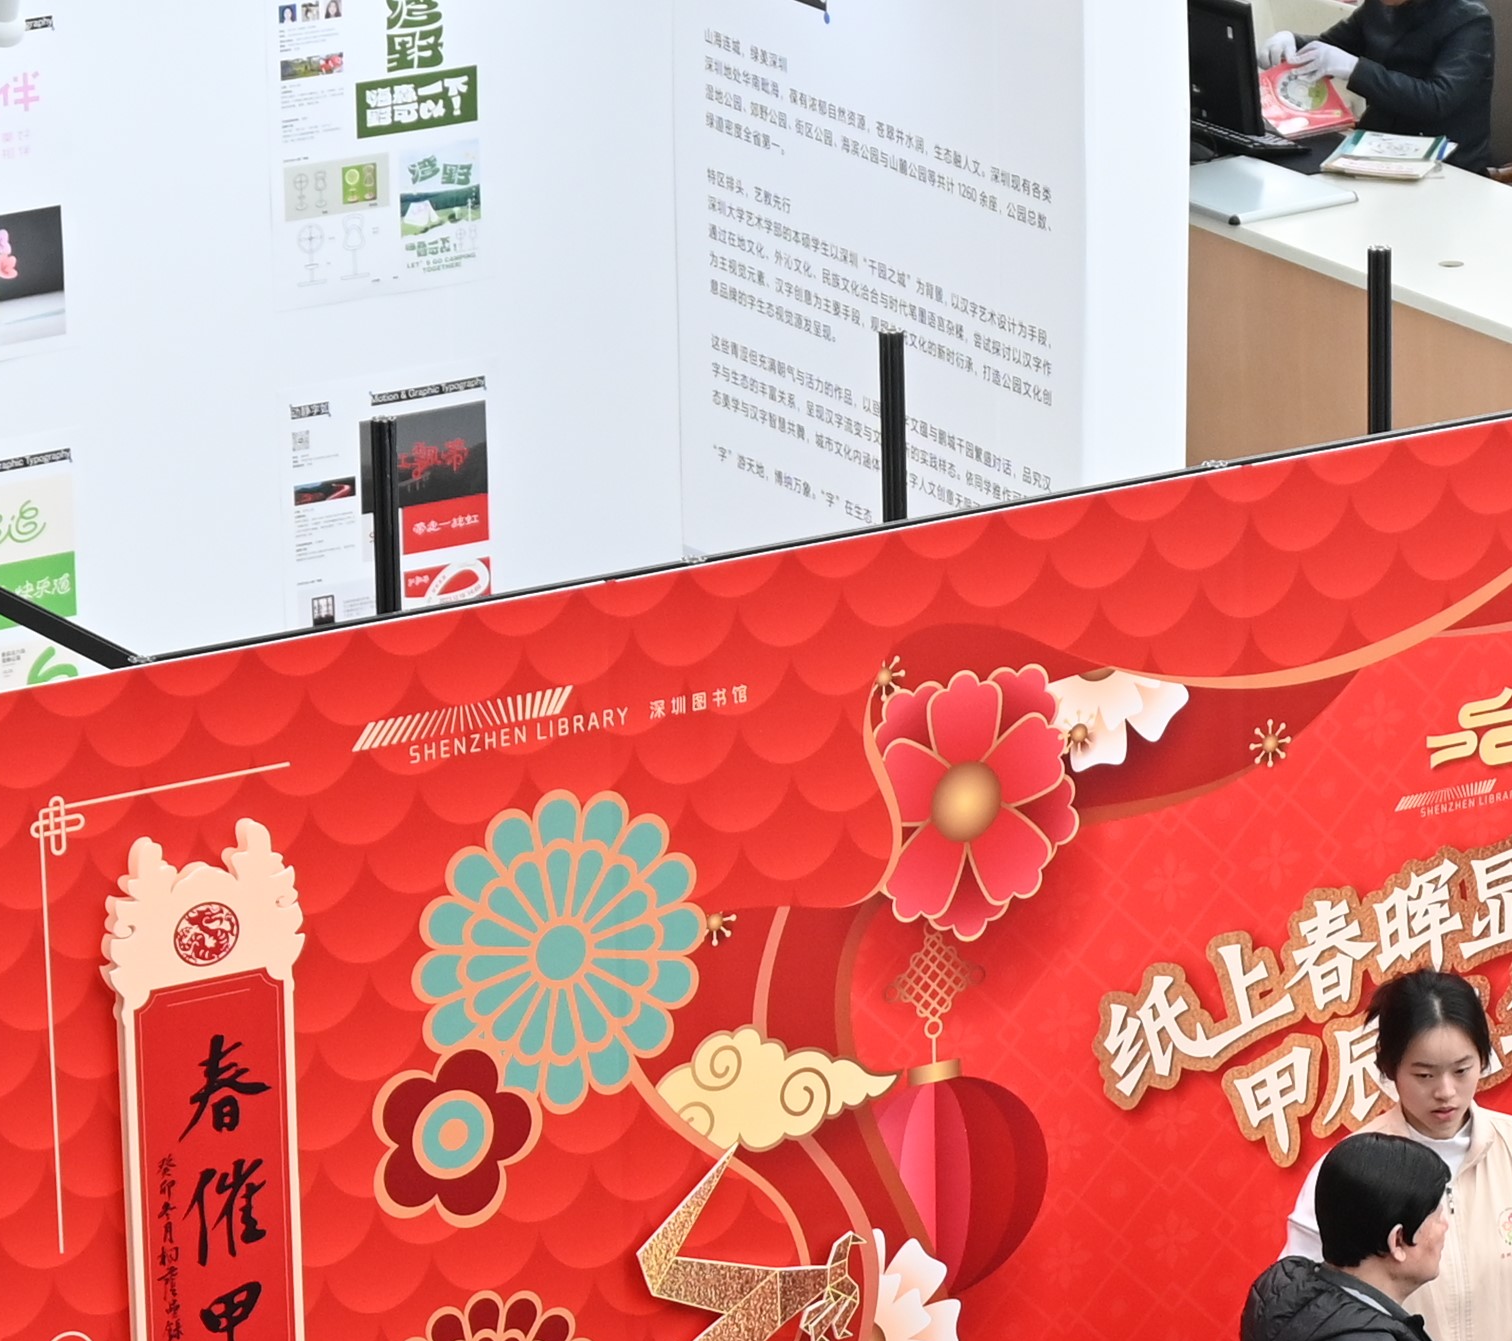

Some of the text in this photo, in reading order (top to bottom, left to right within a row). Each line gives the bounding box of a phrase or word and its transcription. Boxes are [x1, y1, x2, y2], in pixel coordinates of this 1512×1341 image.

[649, 684, 748, 720] 深圳图书馆
[409, 706, 629, 764] SHENZHEN LIBRARY
[1420, 798, 1476, 818] SHENZHEN
